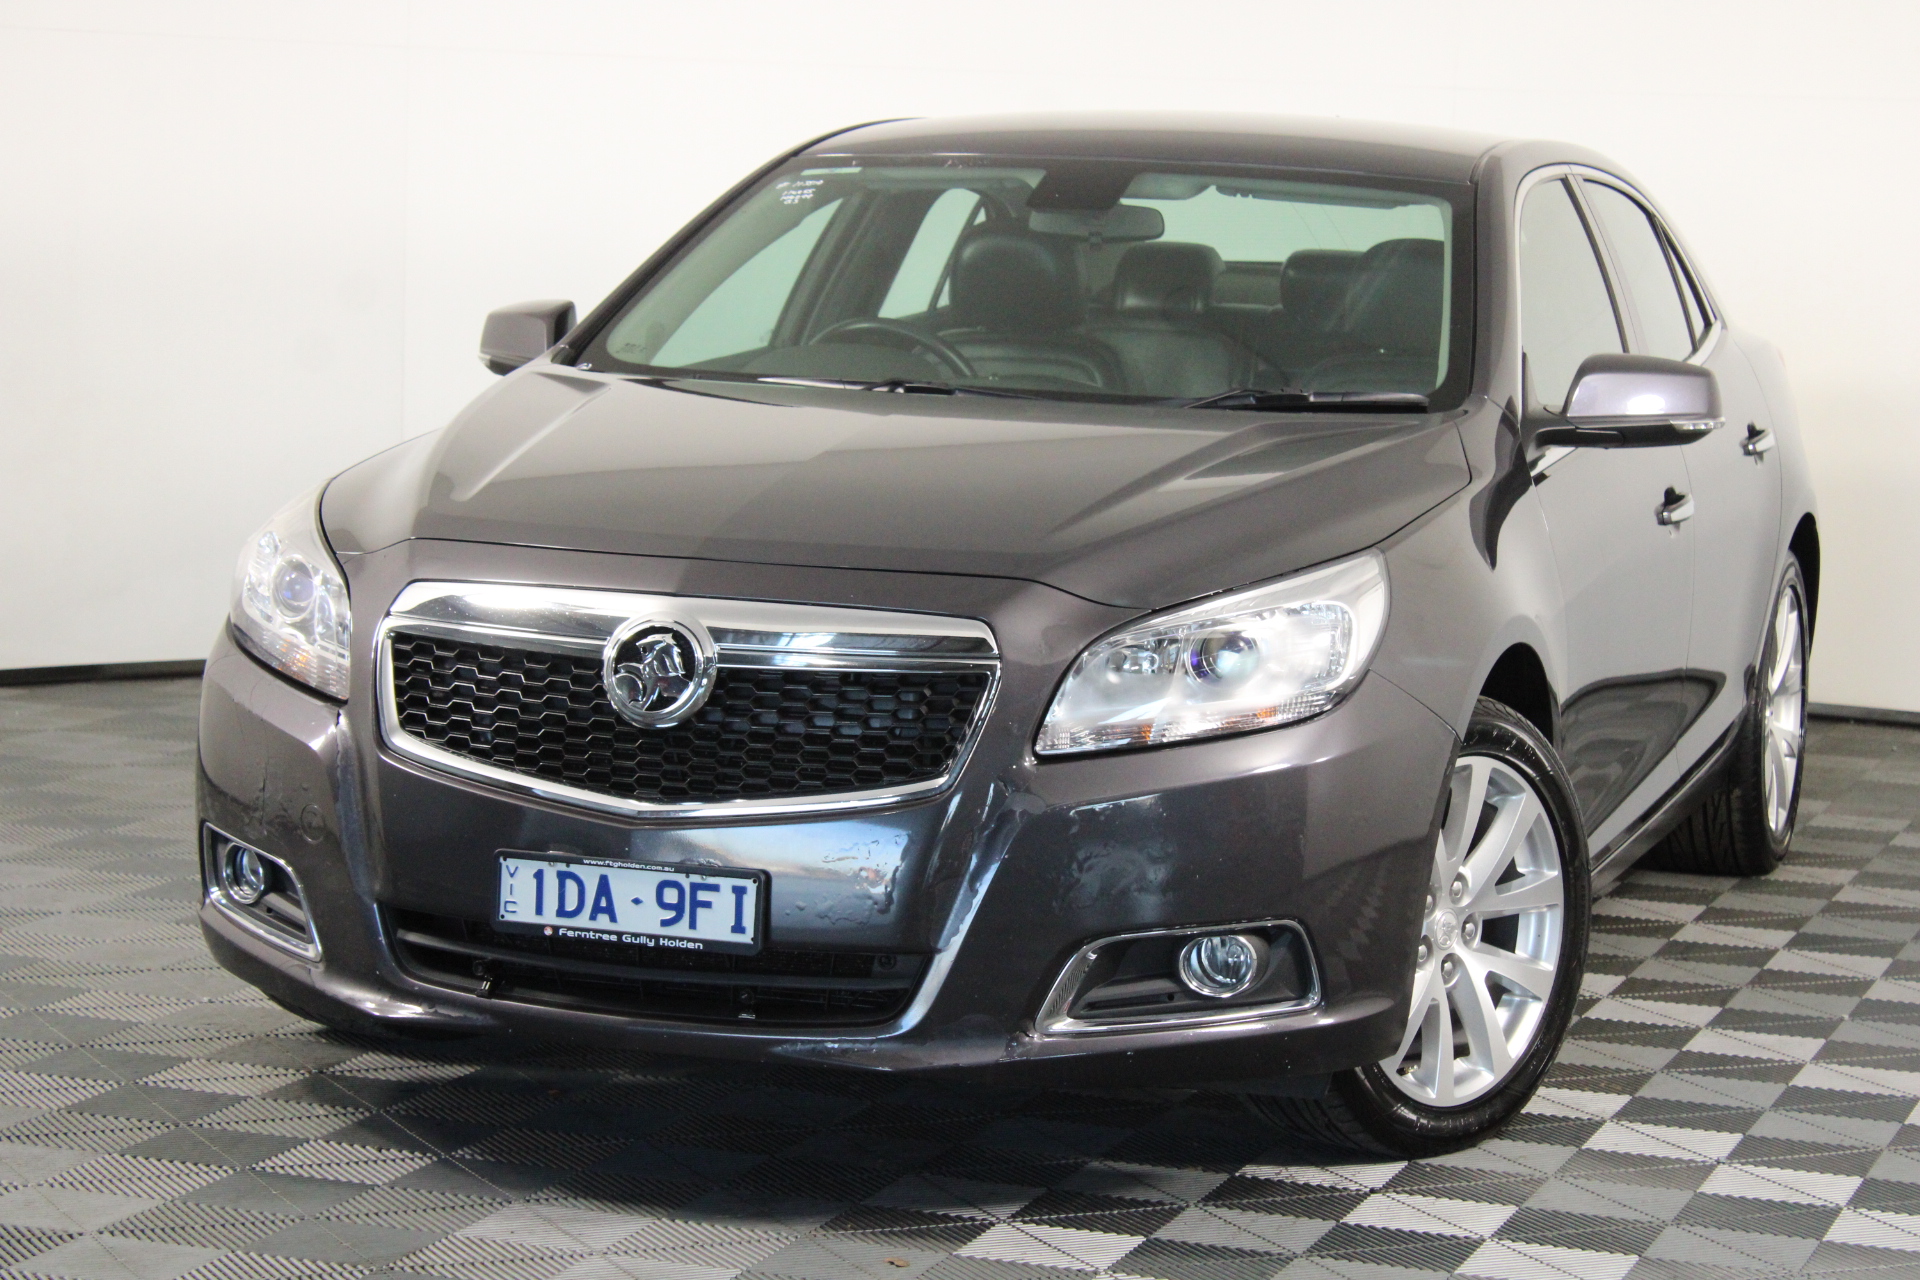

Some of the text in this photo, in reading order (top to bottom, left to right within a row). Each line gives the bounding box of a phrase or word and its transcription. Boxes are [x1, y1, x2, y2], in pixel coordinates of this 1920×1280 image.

[583, 858, 675, 872] www.ftgholden.com.au
[504, 865, 519, 914] VIC
[558, 928, 704, 950] Ferntree Gully Holden
